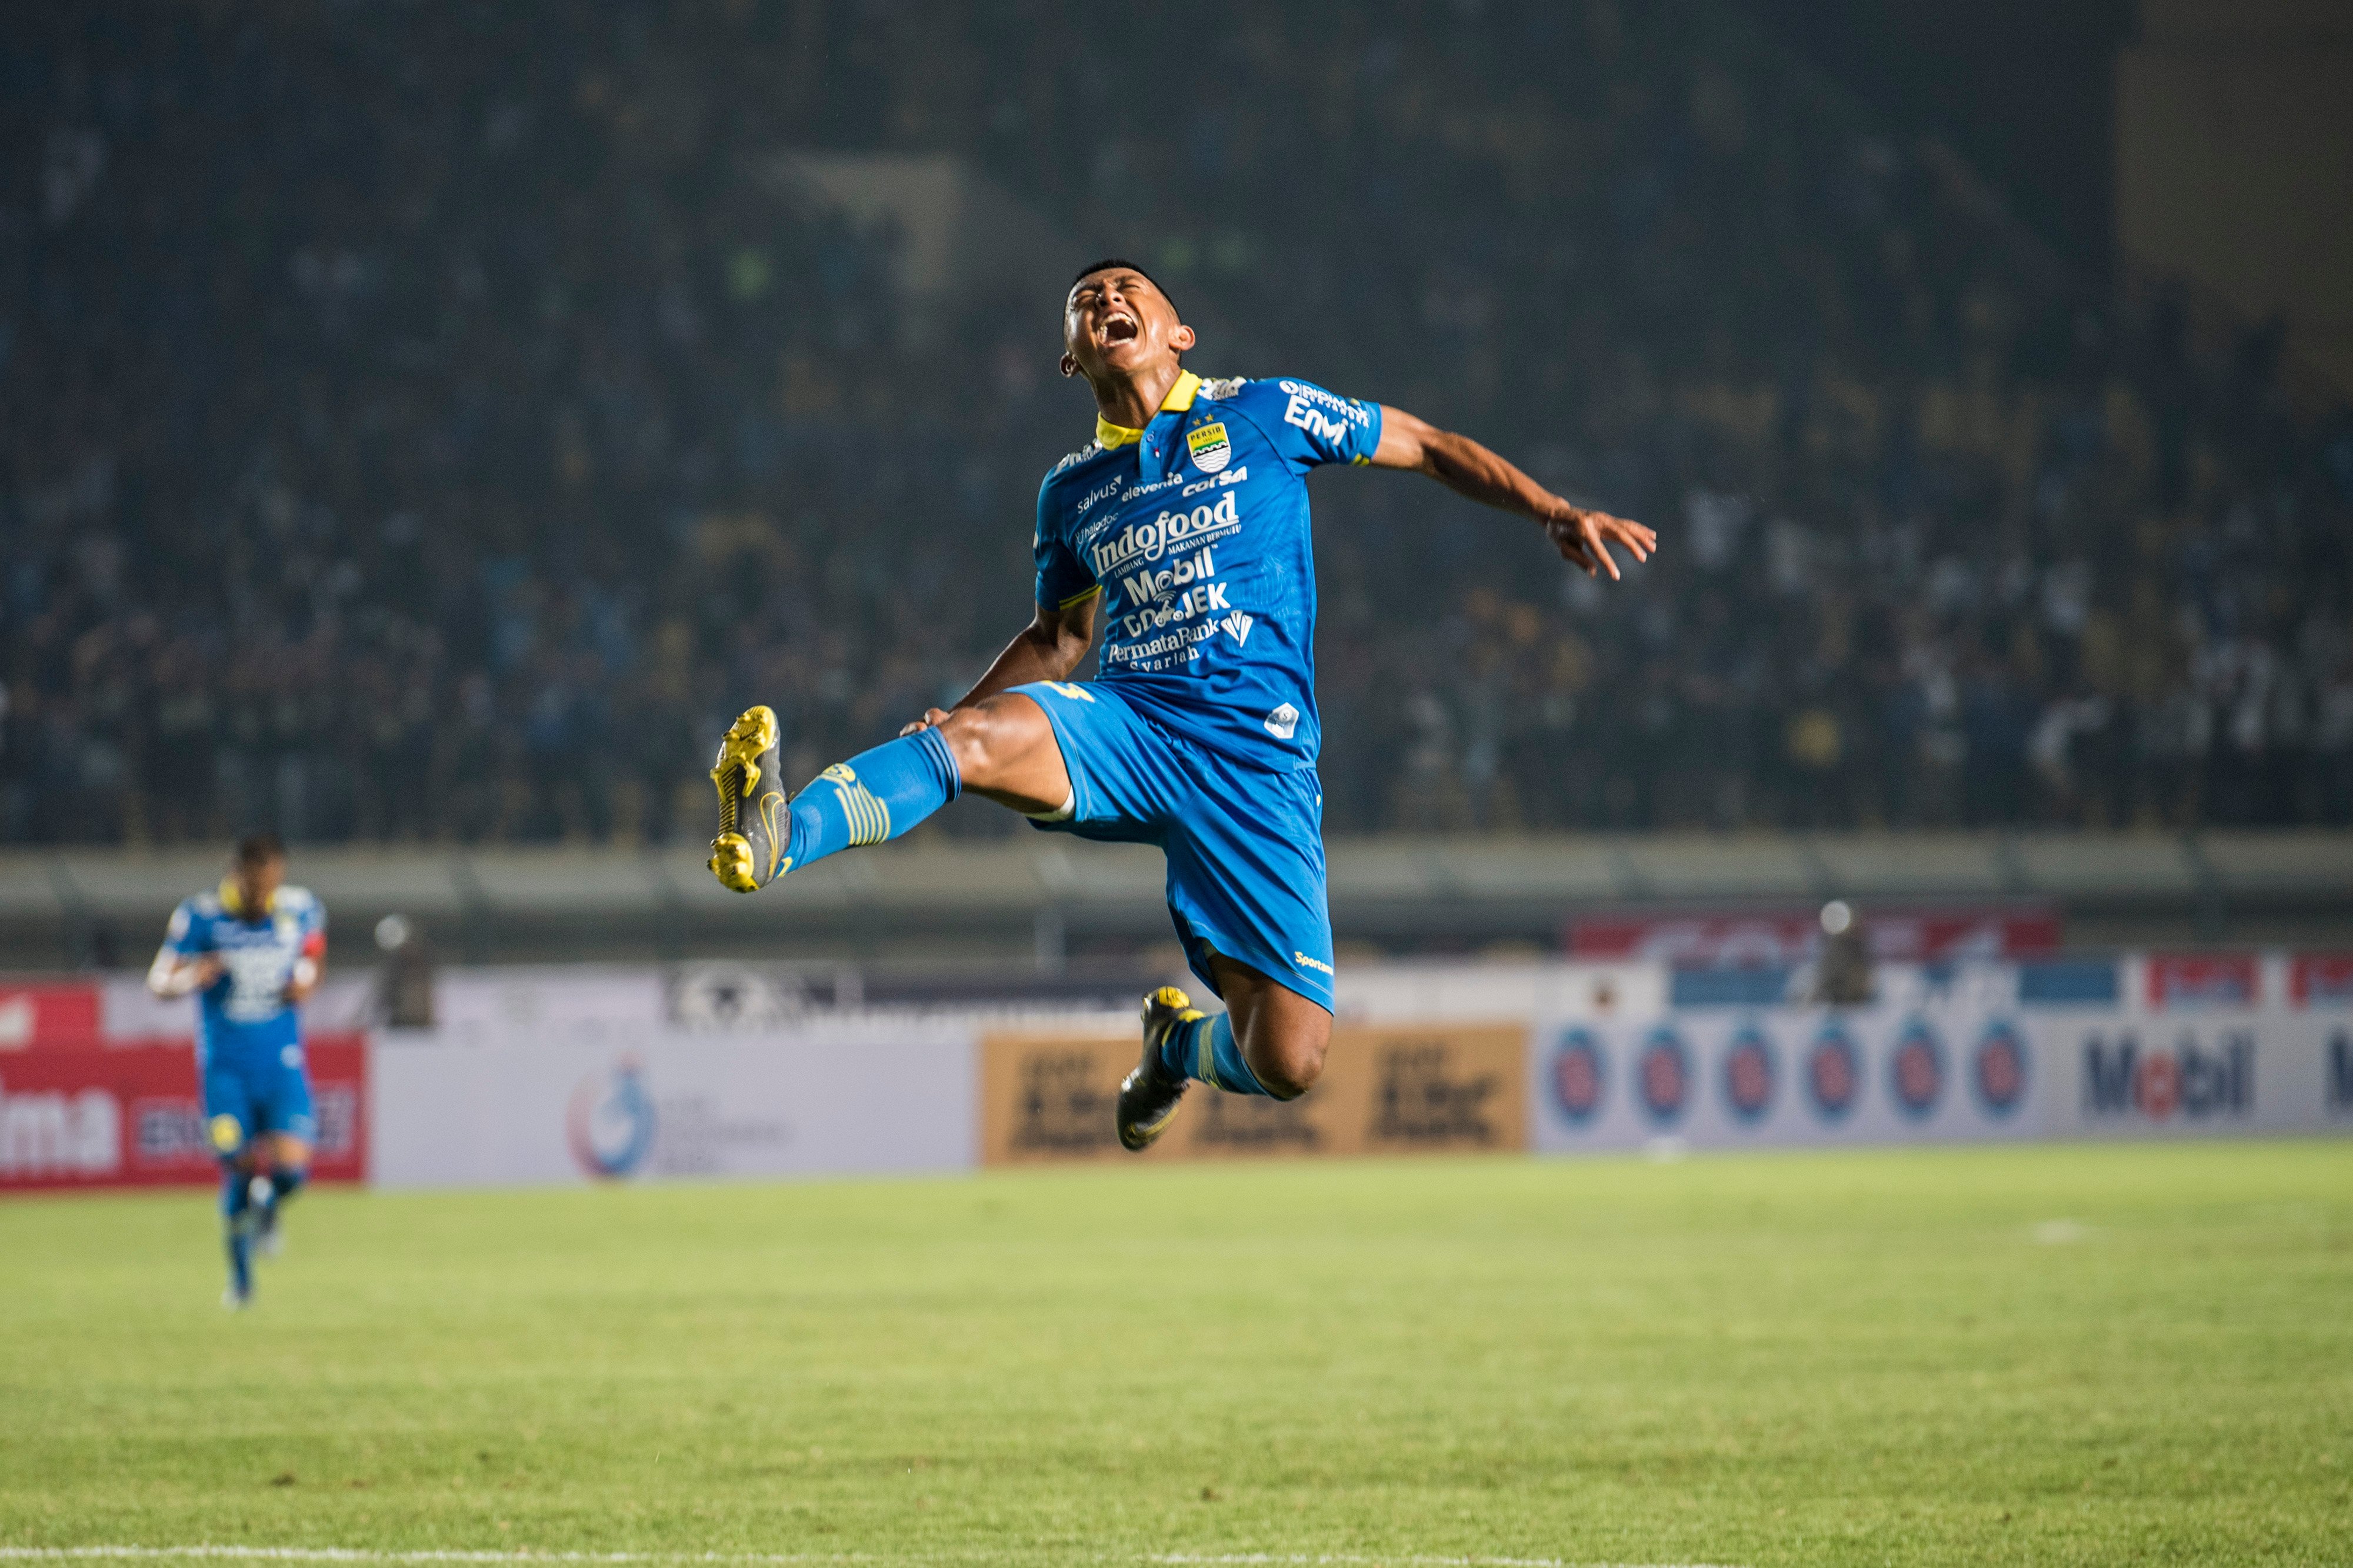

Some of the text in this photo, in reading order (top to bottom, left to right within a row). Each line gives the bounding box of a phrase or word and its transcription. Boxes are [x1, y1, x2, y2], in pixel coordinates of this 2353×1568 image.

[1190, 426, 1221, 441] PERSIB
[1078, 482, 1118, 514] salvus
[1122, 472, 1183, 502] elevenia
[1091, 490, 1239, 578] Indofood
[1168, 535, 1205, 555] MAKANAN
[1123, 546, 1215, 607] Mobil
[1108, 618, 1220, 663] PermataBank
